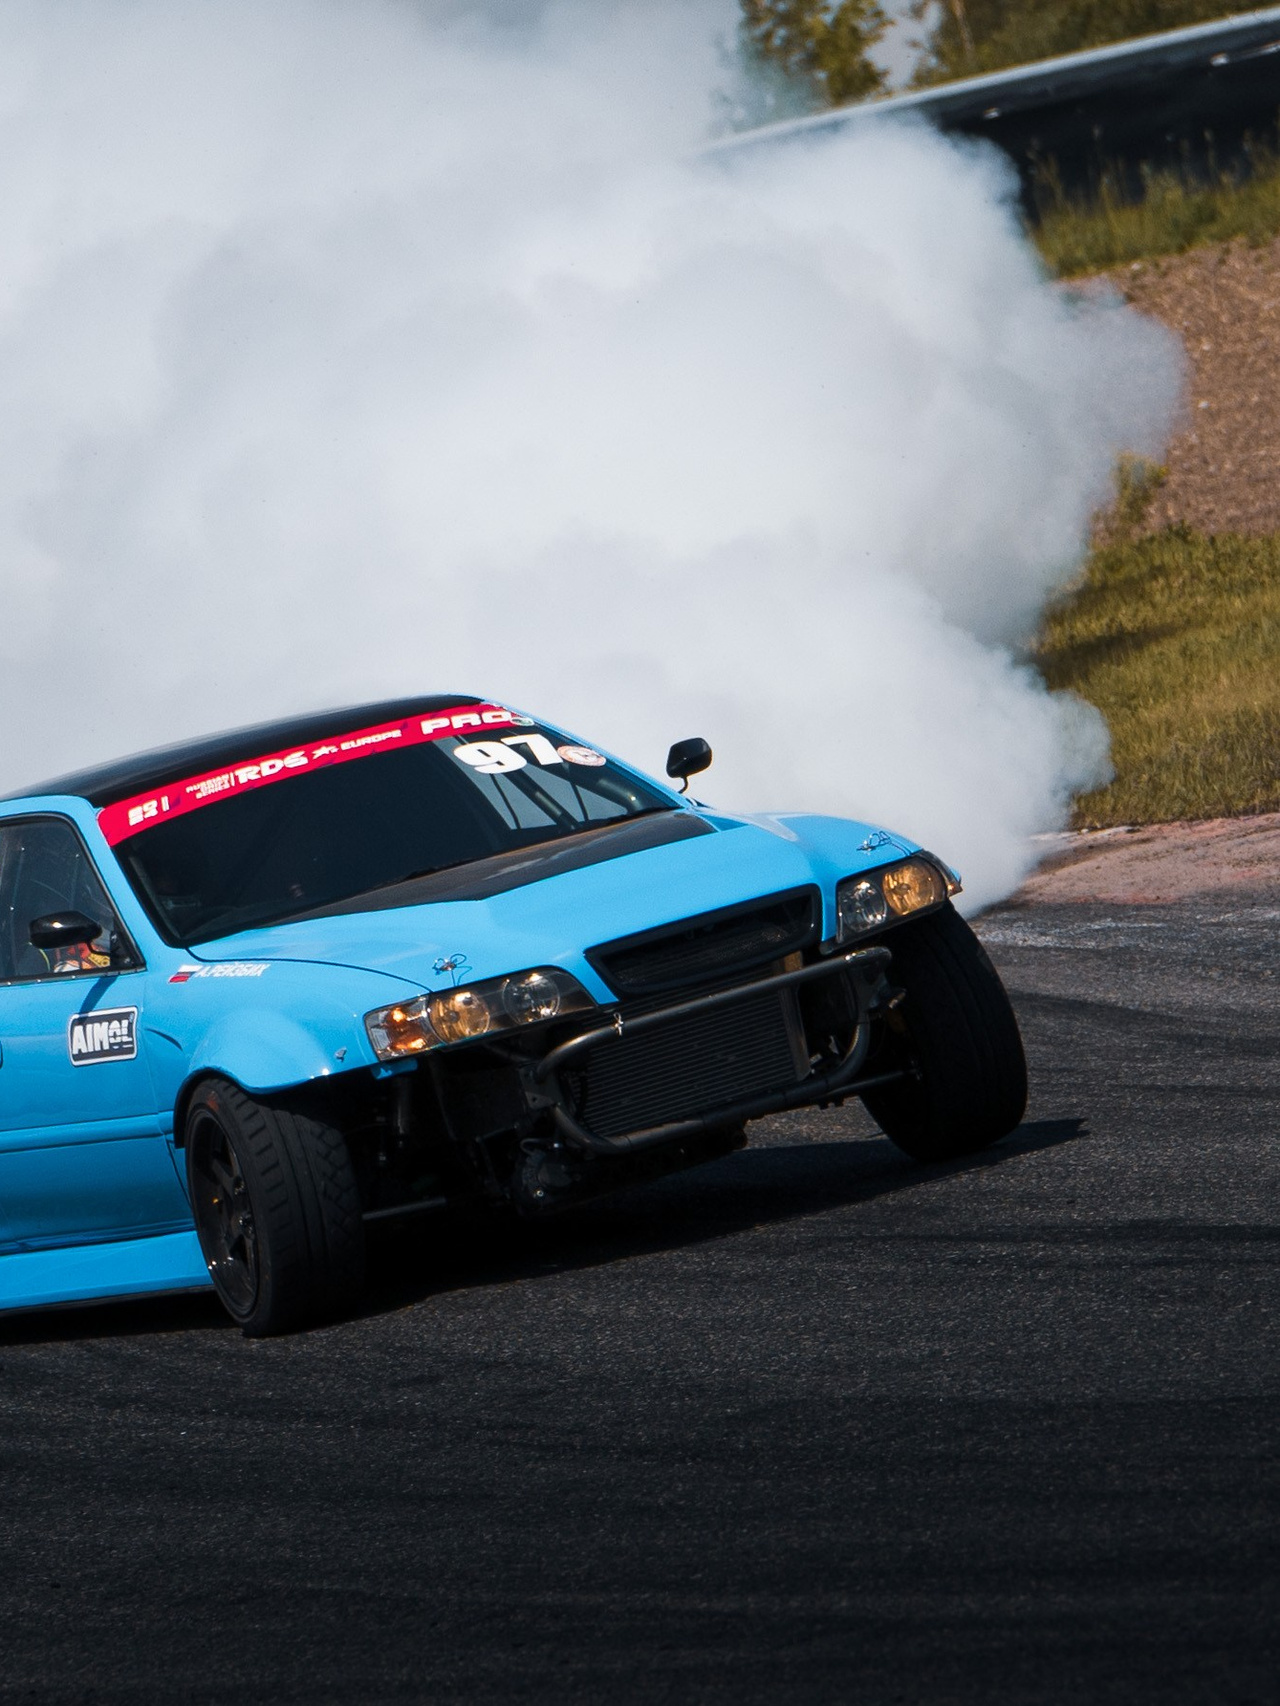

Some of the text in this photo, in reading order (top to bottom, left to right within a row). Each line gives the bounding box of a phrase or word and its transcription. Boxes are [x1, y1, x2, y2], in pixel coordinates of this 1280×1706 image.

[420, 710, 511, 735] PRO
[234, 729, 402, 784] RDS EUROPE
[453, 733, 563, 774] 97
[72, 1019, 133, 1055] AIMOL
